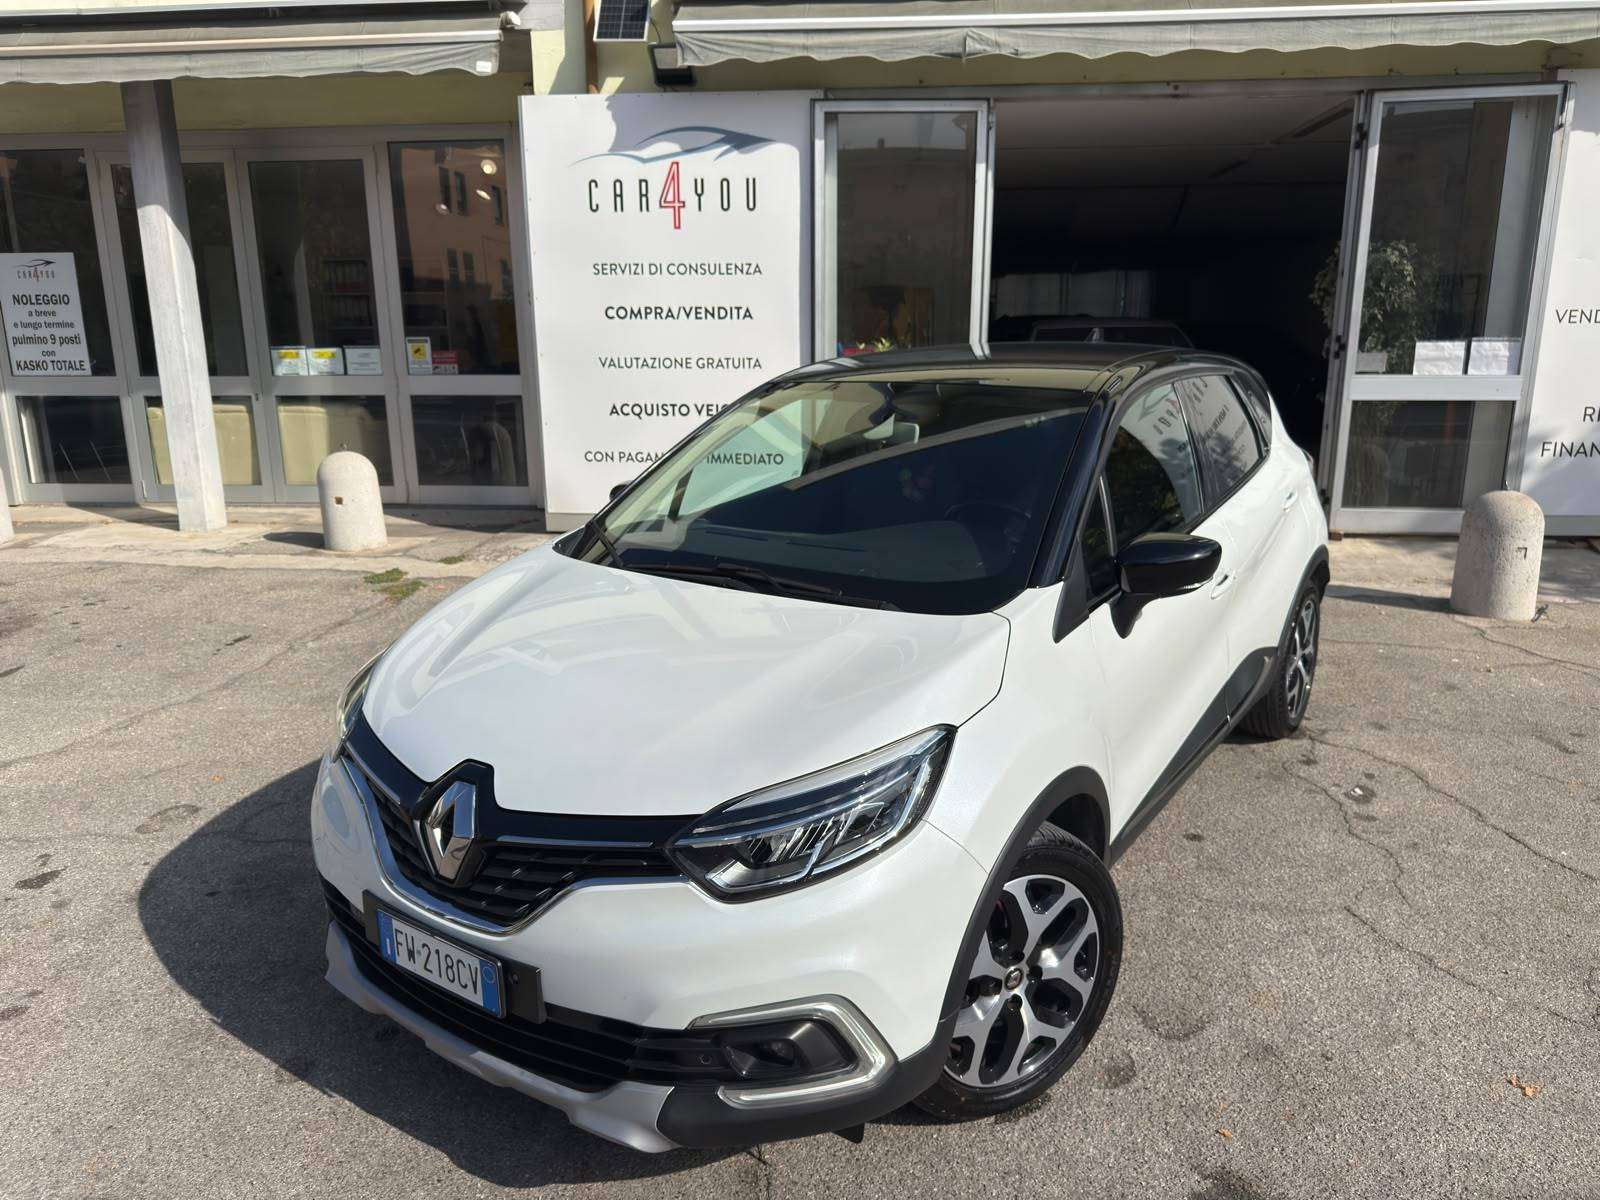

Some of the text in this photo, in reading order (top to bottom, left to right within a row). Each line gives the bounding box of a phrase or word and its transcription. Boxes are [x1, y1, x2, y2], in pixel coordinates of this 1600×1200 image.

[593, 262, 762, 275] SERVIZI DI CONSULENZA
[12, 294, 70, 305] NOLEGGIO
[35, 309, 56, 317] breve
[604, 306, 753, 320] COMPRA/VENDITA
[20, 321, 42, 330] lungo
[44, 321, 74, 329] termine
[12, 334, 81, 347] pulmino 9 posti
[16, 361, 86, 371] KASKO TOTALE
[599, 357, 762, 369] VALUTAZIONE GRATUITA
[609, 404, 690, 419] ACQUISTO
[585, 451, 614, 463] CON
[707, 454, 784, 465] IMMEDIATO
